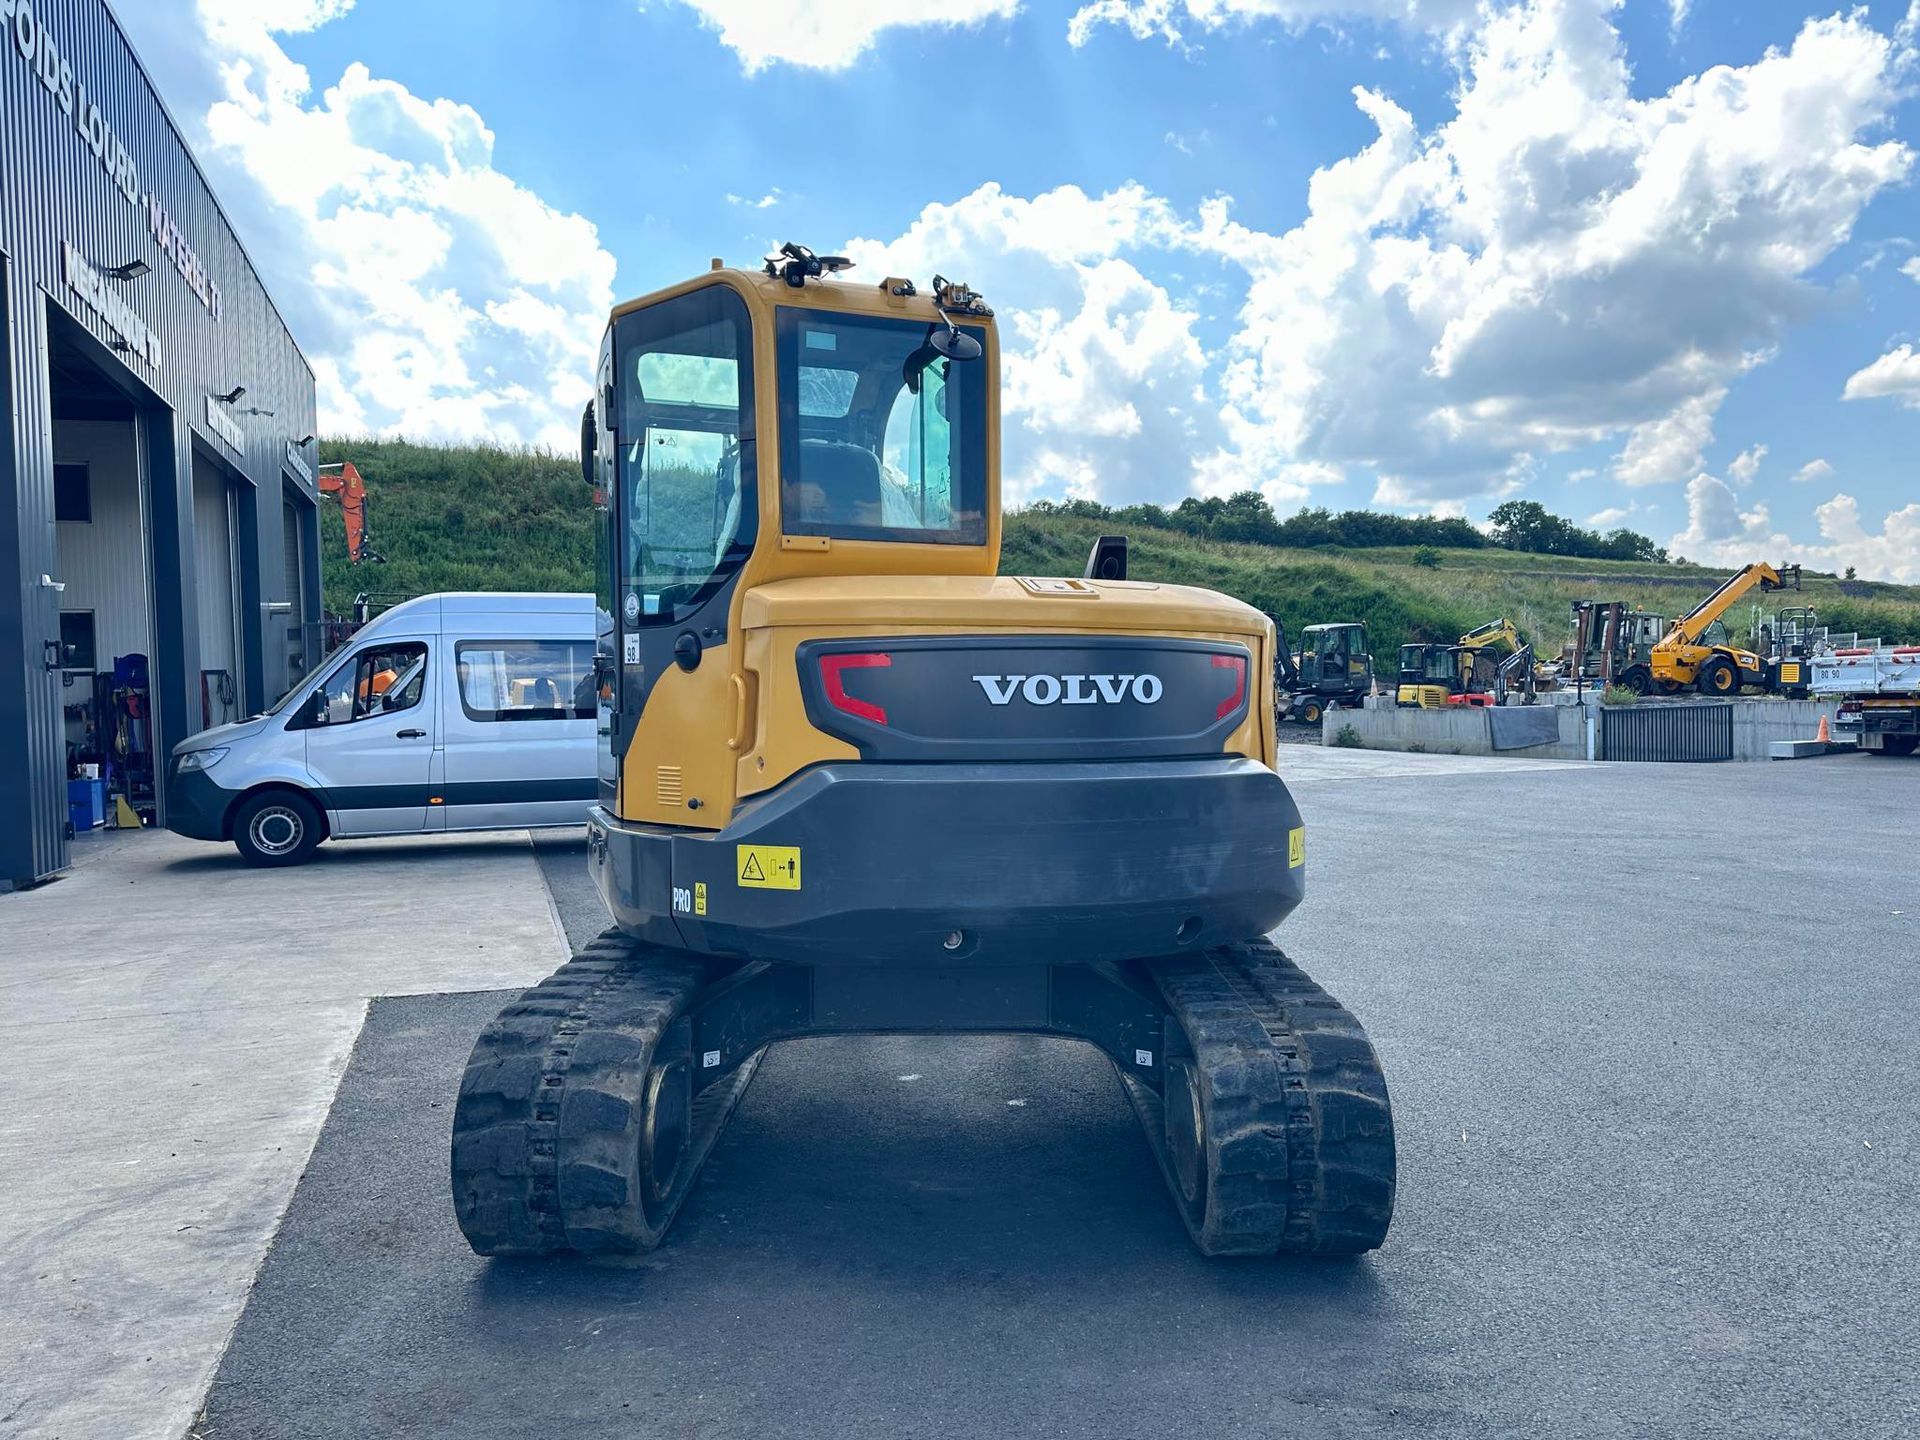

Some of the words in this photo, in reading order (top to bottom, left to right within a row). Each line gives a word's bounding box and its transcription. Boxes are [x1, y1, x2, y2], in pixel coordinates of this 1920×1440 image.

[627, 646, 636, 662] 98
[1820, 670, 1829, 679] 80
[1831, 669, 1840, 679] 90
[972, 674, 1163, 705] VOLVO
[673, 887, 691, 913] PRO
